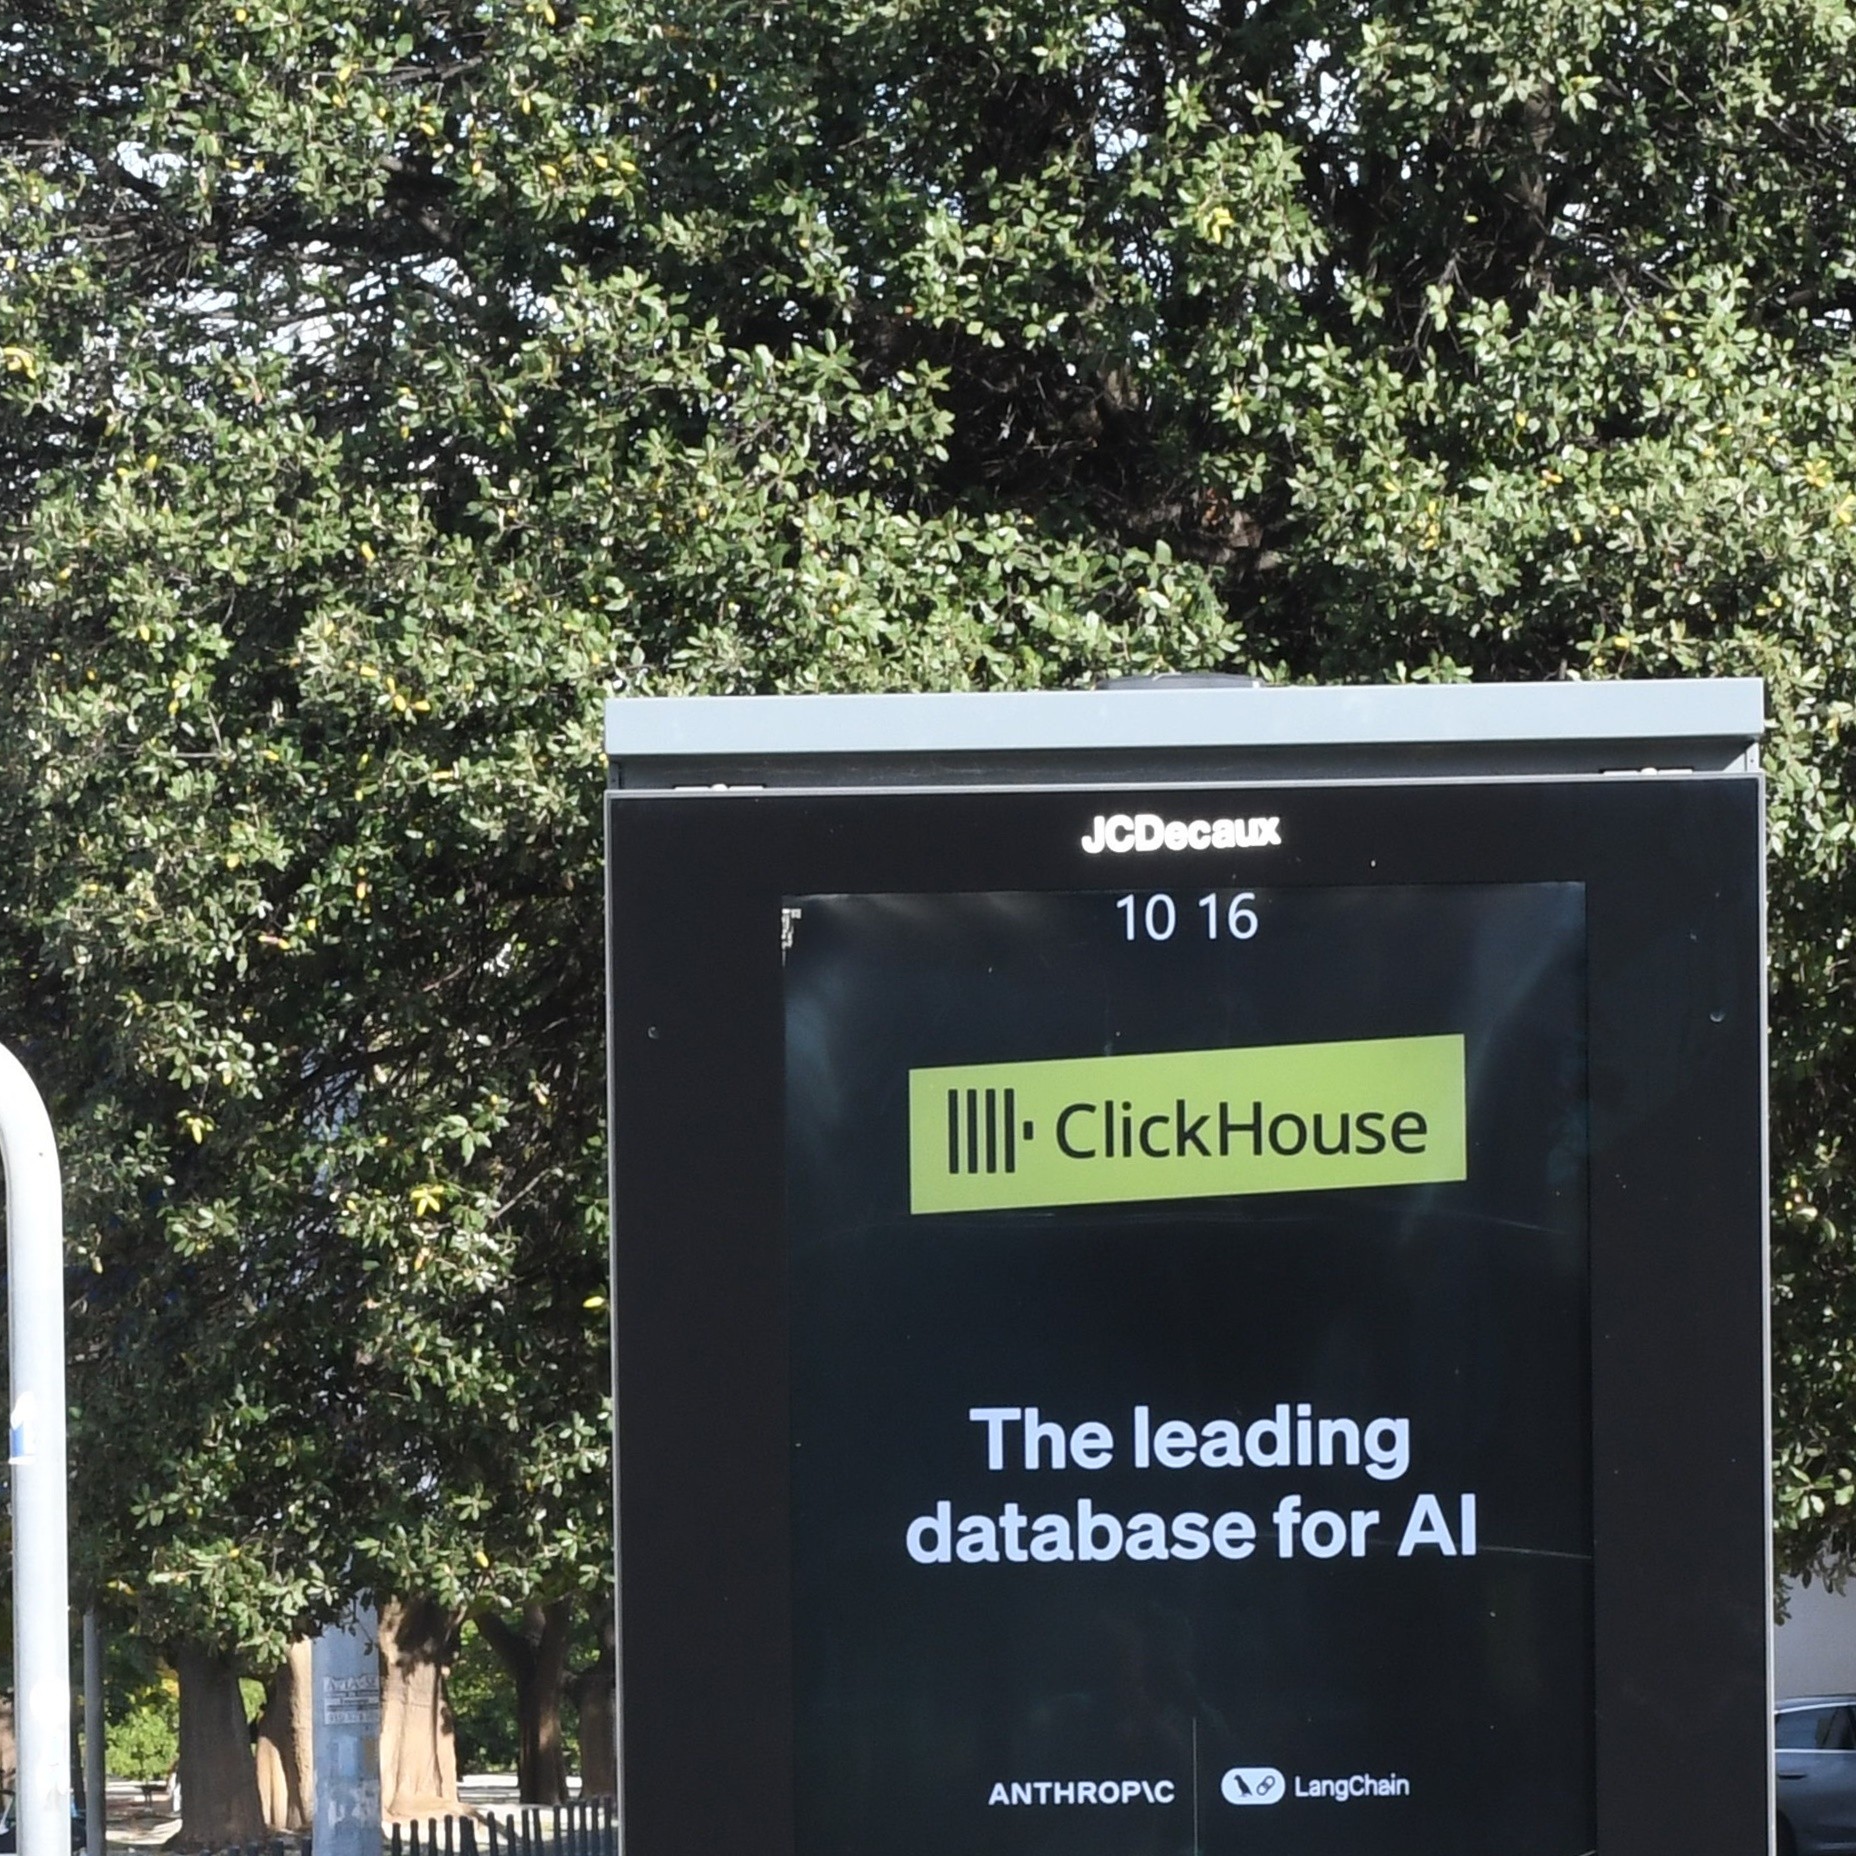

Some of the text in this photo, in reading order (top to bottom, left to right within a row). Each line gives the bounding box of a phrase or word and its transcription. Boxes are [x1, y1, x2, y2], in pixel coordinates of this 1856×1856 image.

[1081, 814, 1282, 854] JCDecaux
[1116, 892, 1258, 941] 10 16
[1056, 1099, 1428, 1160] ClickHouse
[969, 1403, 1410, 1481] The leading
[906, 1493, 1477, 1564] database for AI
[1294, 1772, 1410, 1802] LangChain
